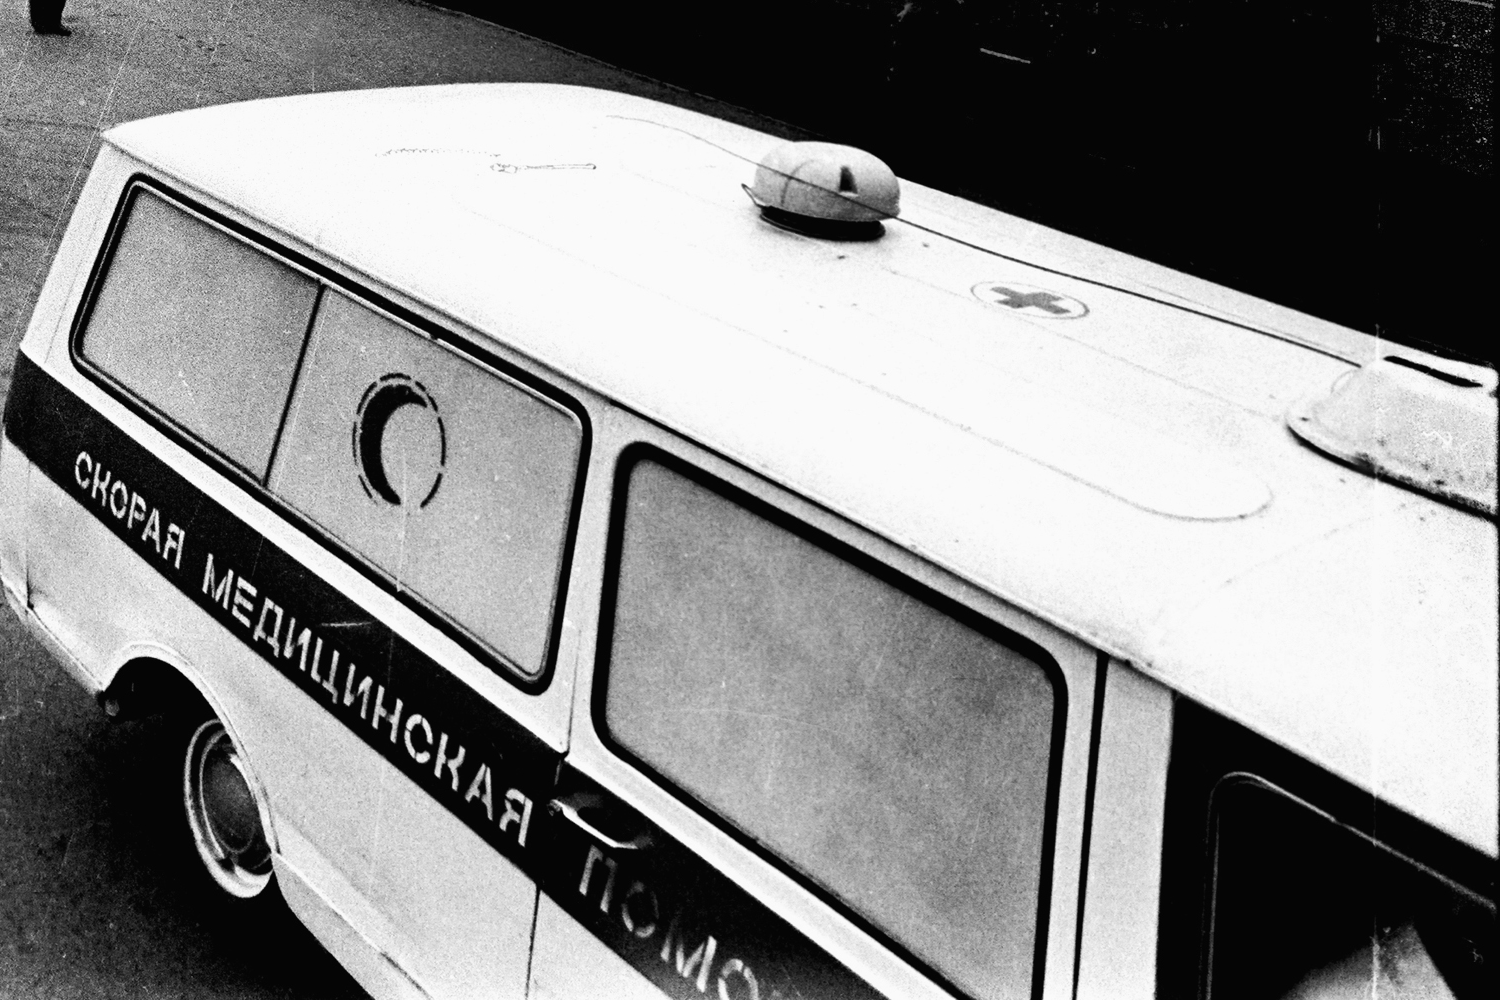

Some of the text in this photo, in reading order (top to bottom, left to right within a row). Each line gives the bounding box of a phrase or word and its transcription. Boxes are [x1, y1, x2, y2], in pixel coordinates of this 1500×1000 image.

[73, 450, 770, 1000] СКОРАЯ МЕДИЦИНСКАЯ ПОМО
